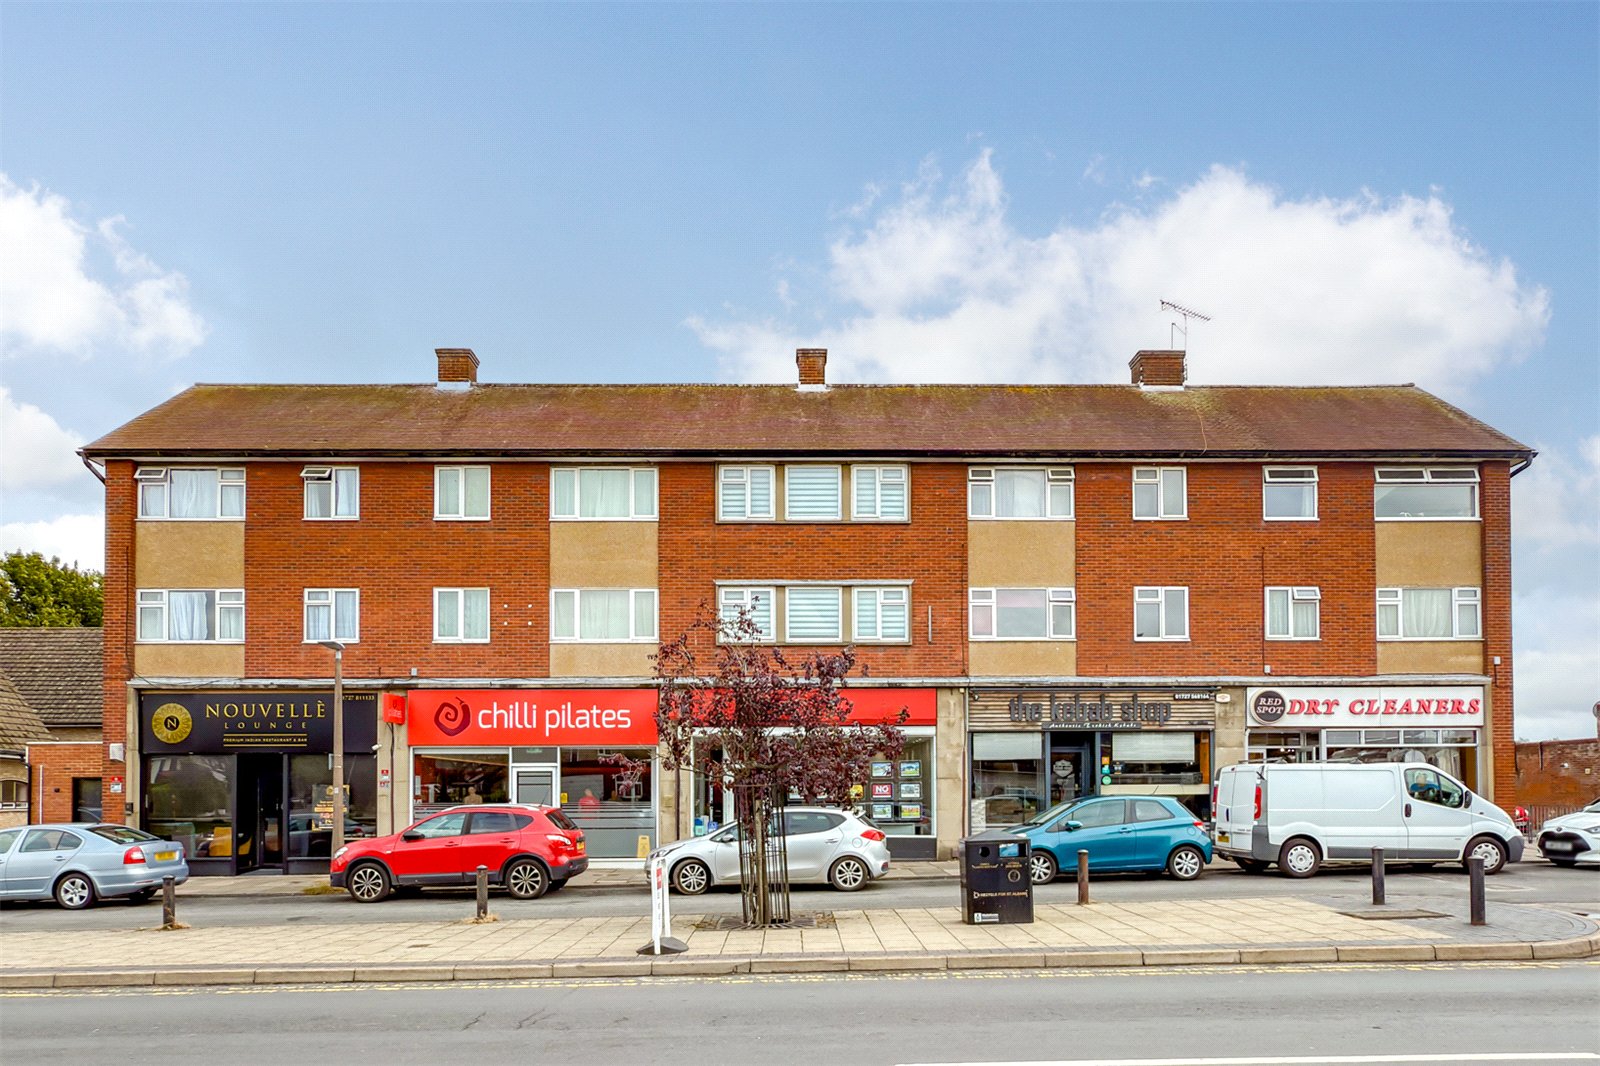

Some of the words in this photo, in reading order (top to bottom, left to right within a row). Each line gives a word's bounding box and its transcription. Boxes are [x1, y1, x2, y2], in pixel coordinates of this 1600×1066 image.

[1259, 698, 1282, 706] RED
[1286, 699, 1340, 715] DRY
[1348, 698, 1481, 715] CLEANERS
[205, 700, 326, 718] NOUVELLÈ
[1009, 694, 1042, 721] the
[1050, 694, 1113, 721] kebab
[1120, 694, 1171, 727] shop
[1256, 706, 1284, 714] SPOT
[167, 718, 177, 728] N
[478, 701, 537, 729] chilli
[545, 701, 632, 737] pilates
[224, 722, 307, 730] LOUNGE
[875, 785, 889, 794] NO
